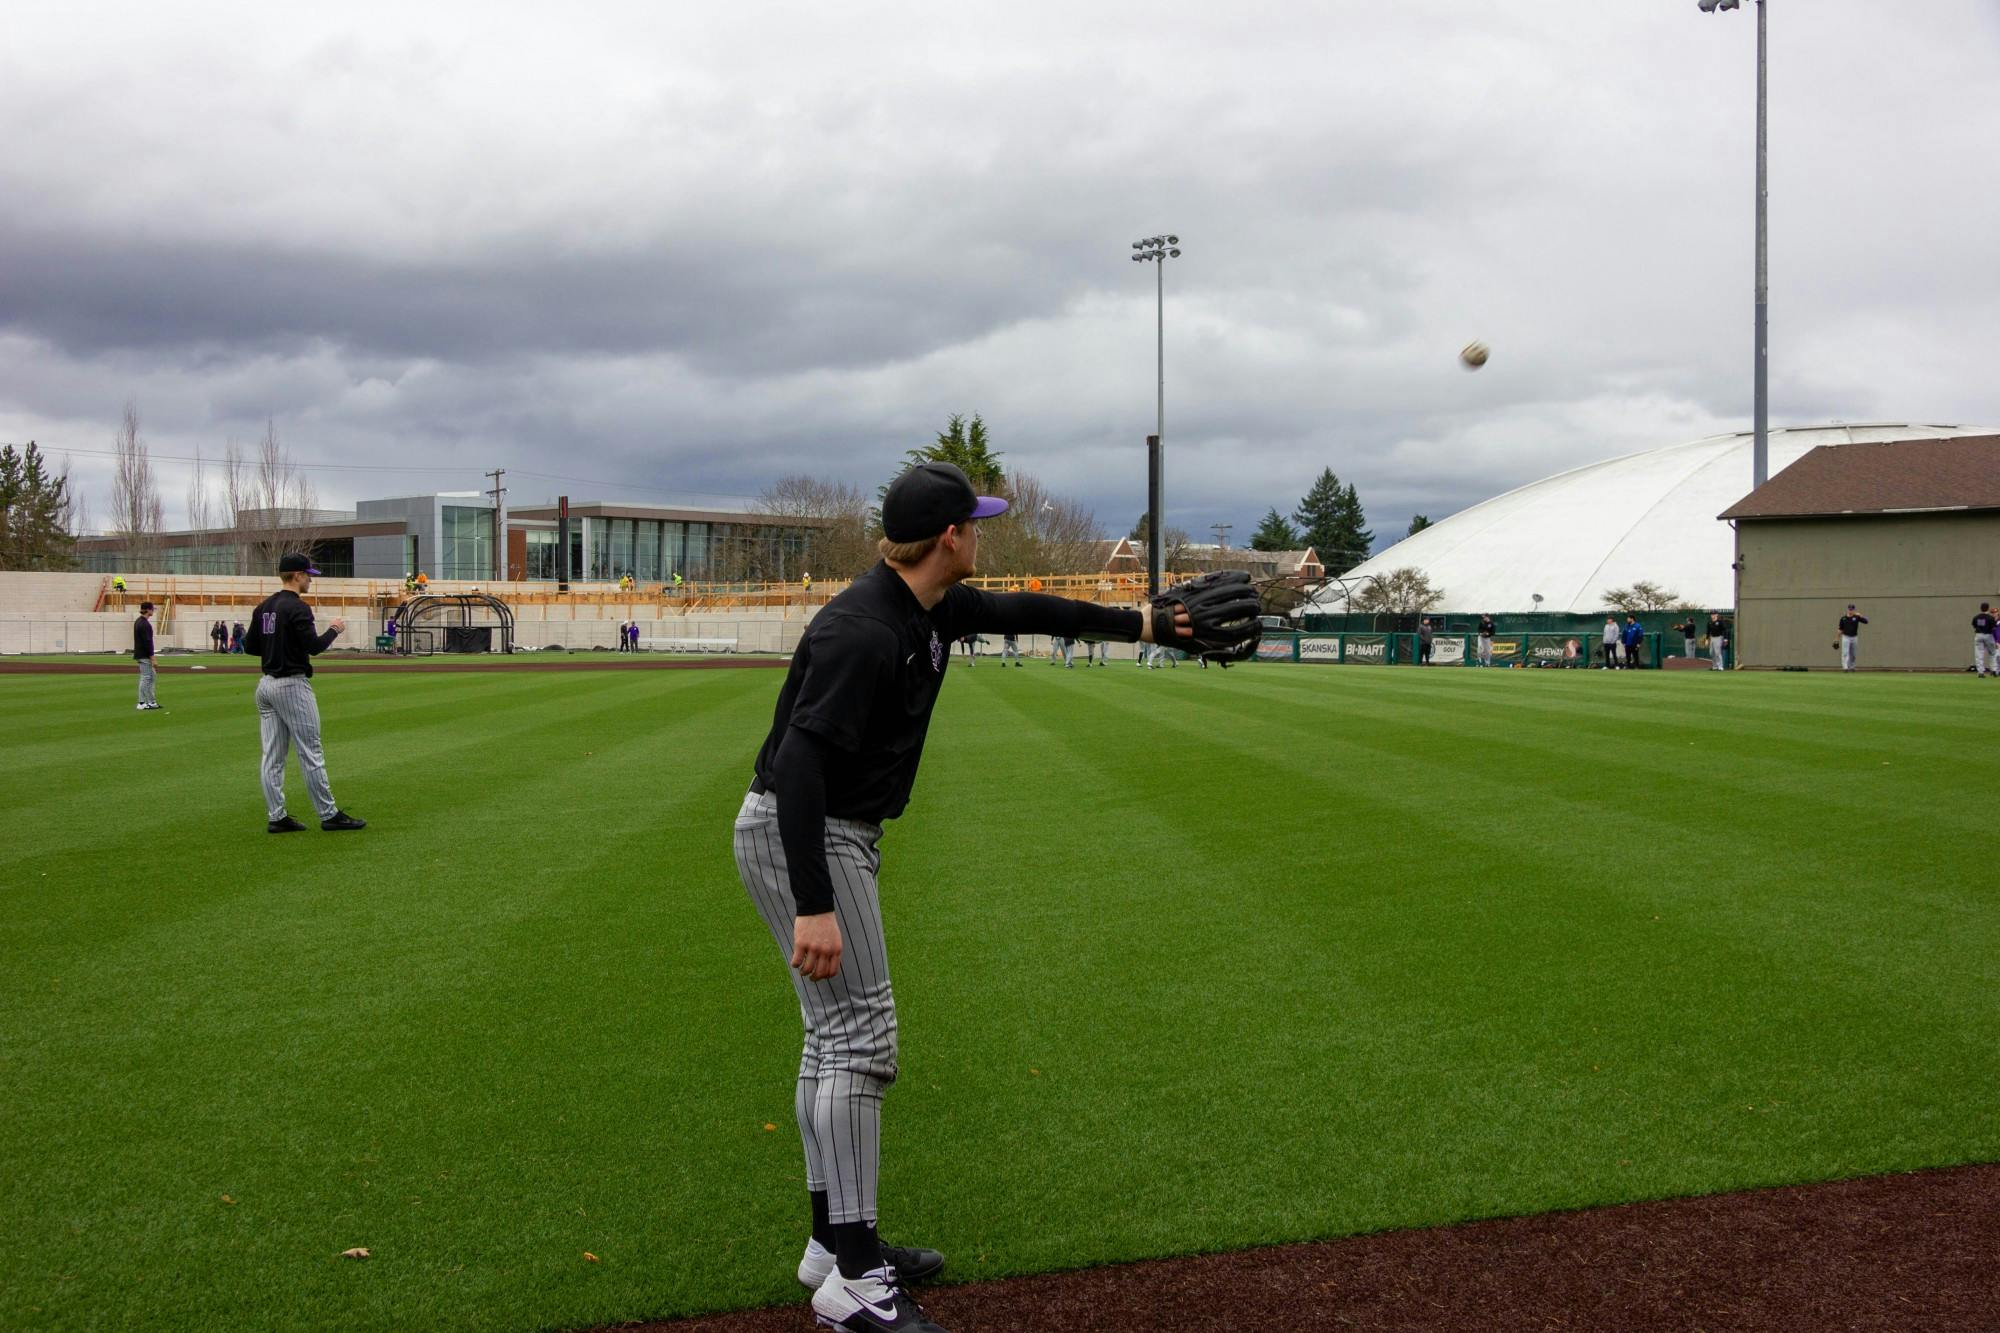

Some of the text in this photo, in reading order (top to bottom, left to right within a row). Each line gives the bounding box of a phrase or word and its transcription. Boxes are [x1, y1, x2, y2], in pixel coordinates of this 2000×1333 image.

[263, 612, 277, 634] 16
[1301, 643, 1337, 654] SKANSKA
[1534, 647, 1565, 657] SAFEWAY
